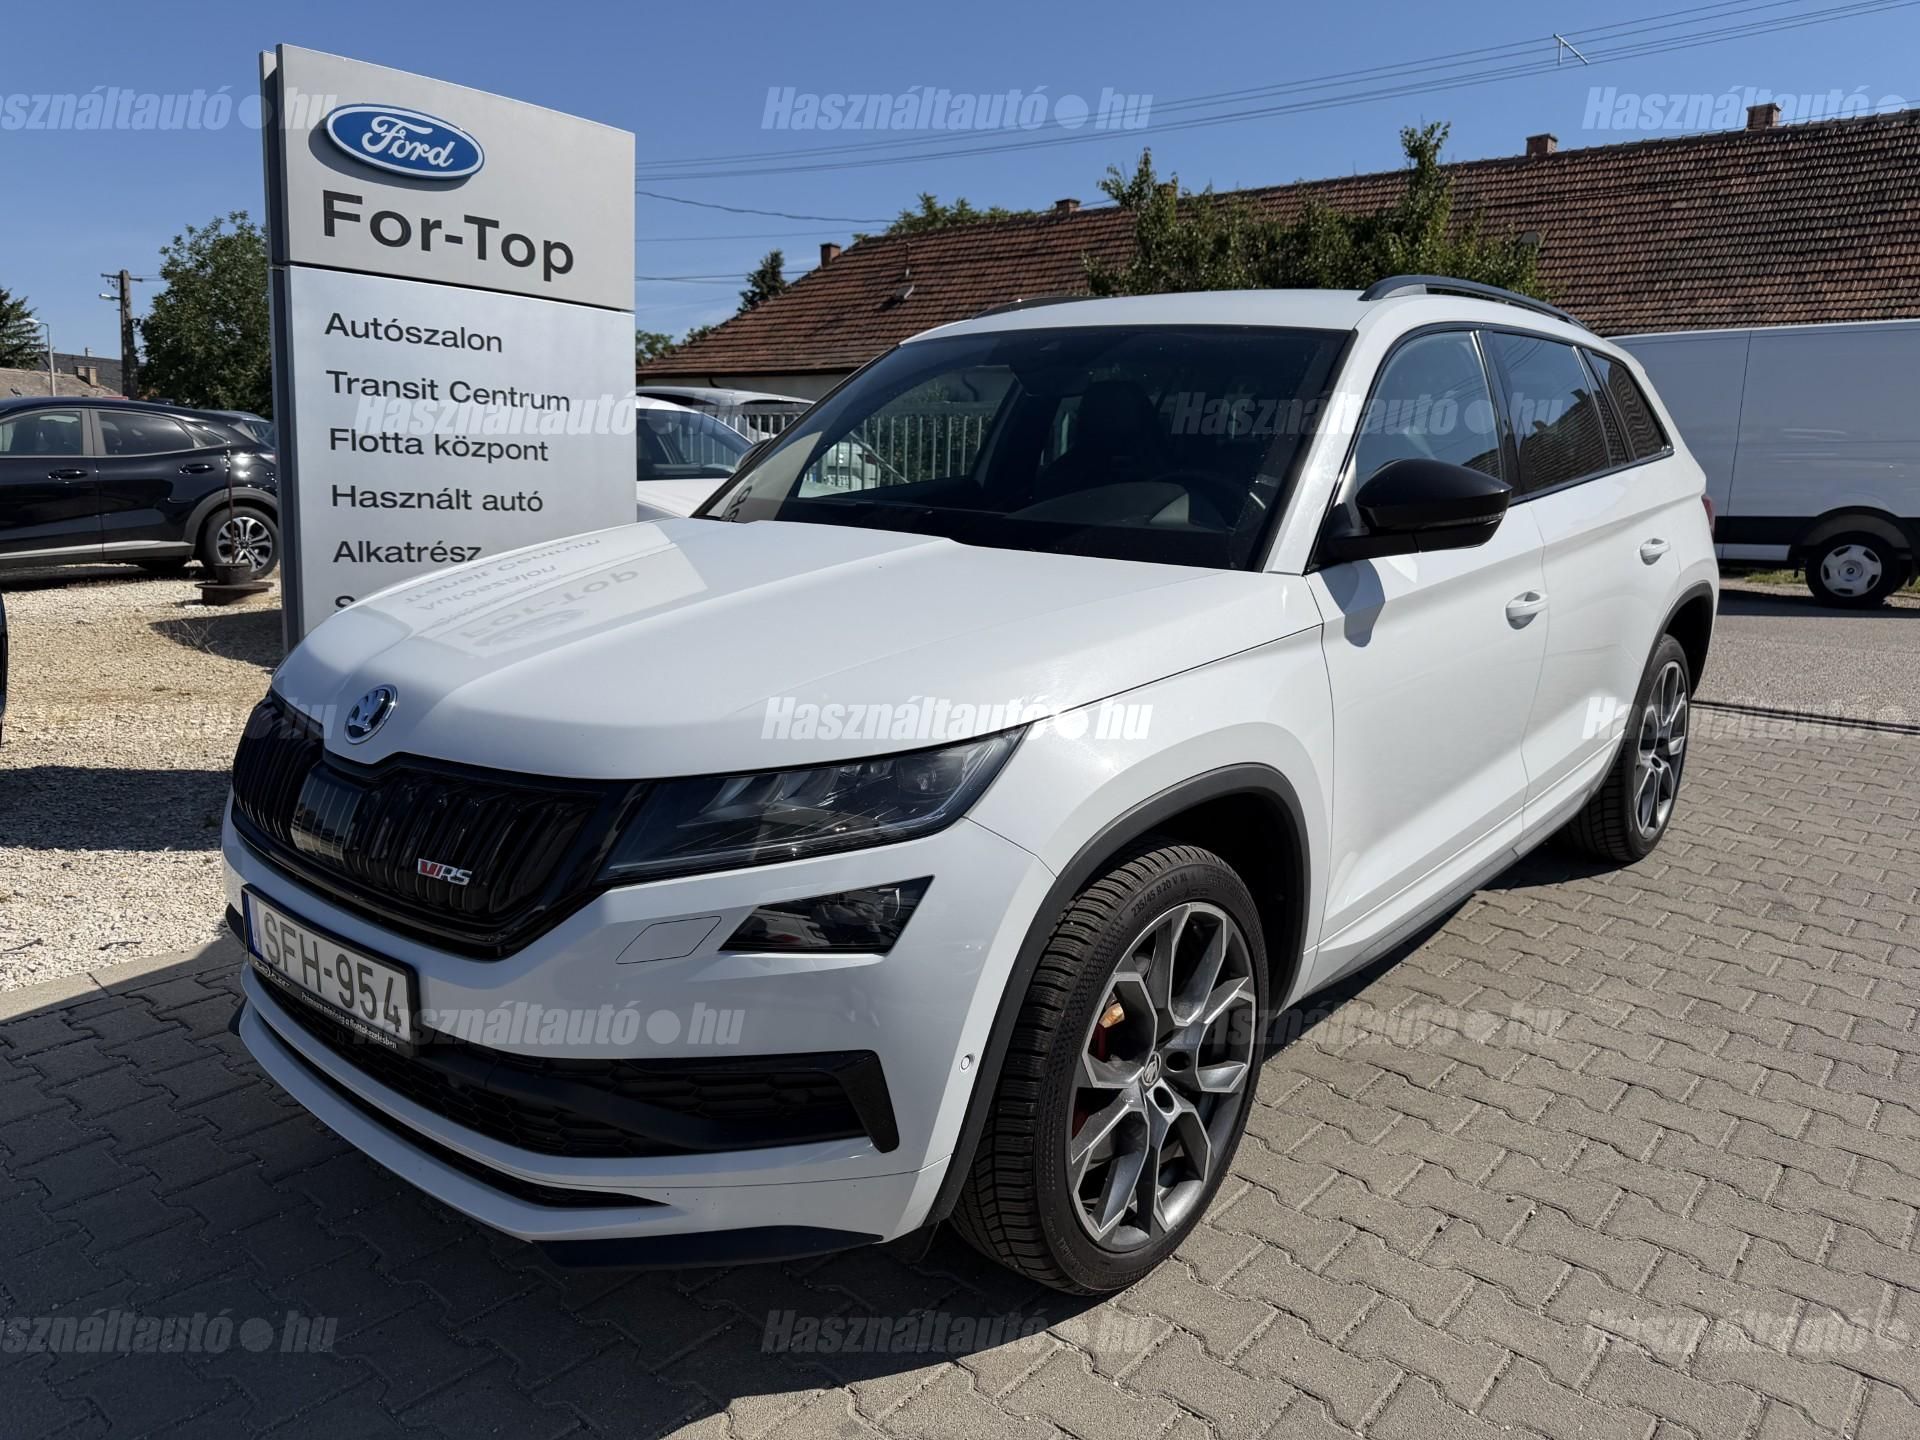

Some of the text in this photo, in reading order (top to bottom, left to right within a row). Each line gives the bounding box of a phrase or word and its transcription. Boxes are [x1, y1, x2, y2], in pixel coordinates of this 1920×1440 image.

[361, 115, 455, 168] Ford
[322, 189, 575, 283] For-Top
[324, 312, 503, 353] Autószalon
[326, 369, 571, 412] Transit Centrum
[330, 427, 549, 463] Flotta központ
[331, 484, 544, 513] Használt autó
[332, 540, 482, 563] Alkatrész
[264, 911, 402, 1034] SFH-954
